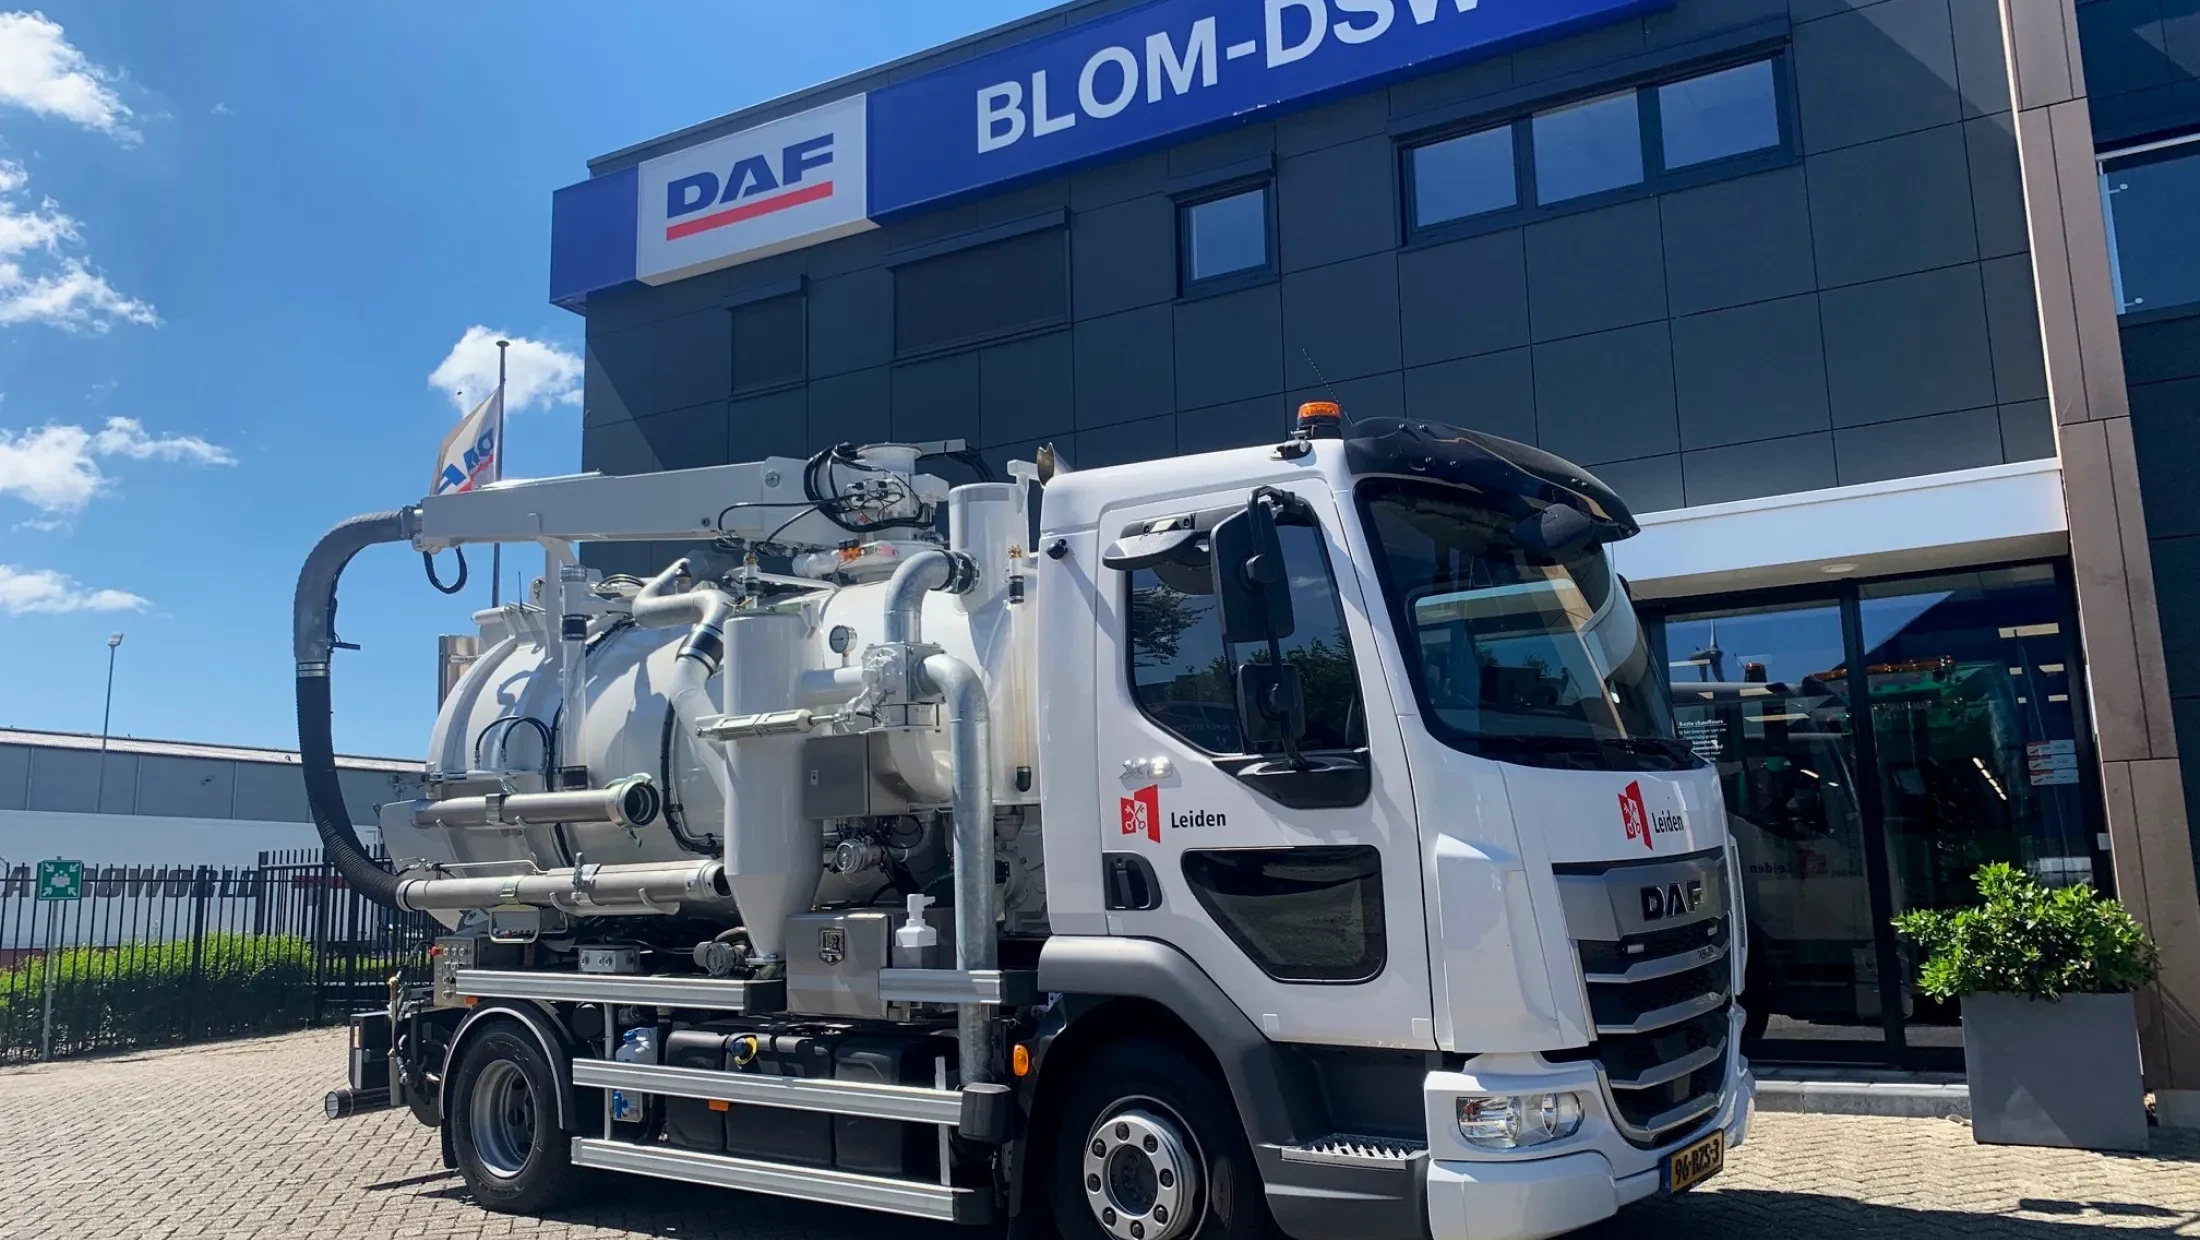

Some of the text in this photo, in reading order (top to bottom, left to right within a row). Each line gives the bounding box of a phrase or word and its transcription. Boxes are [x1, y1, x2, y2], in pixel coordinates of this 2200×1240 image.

[977, 0, 1479, 154] BLOM-DS
[667, 133, 834, 219] DAF
[1171, 810, 1226, 829] Leiden
[1652, 810, 1684, 834] Leiden
[0, 866, 262, 898] AOWORLD
[1640, 880, 1704, 922] DAF
[1675, 1138, 1719, 1185] 96-BZS-3
